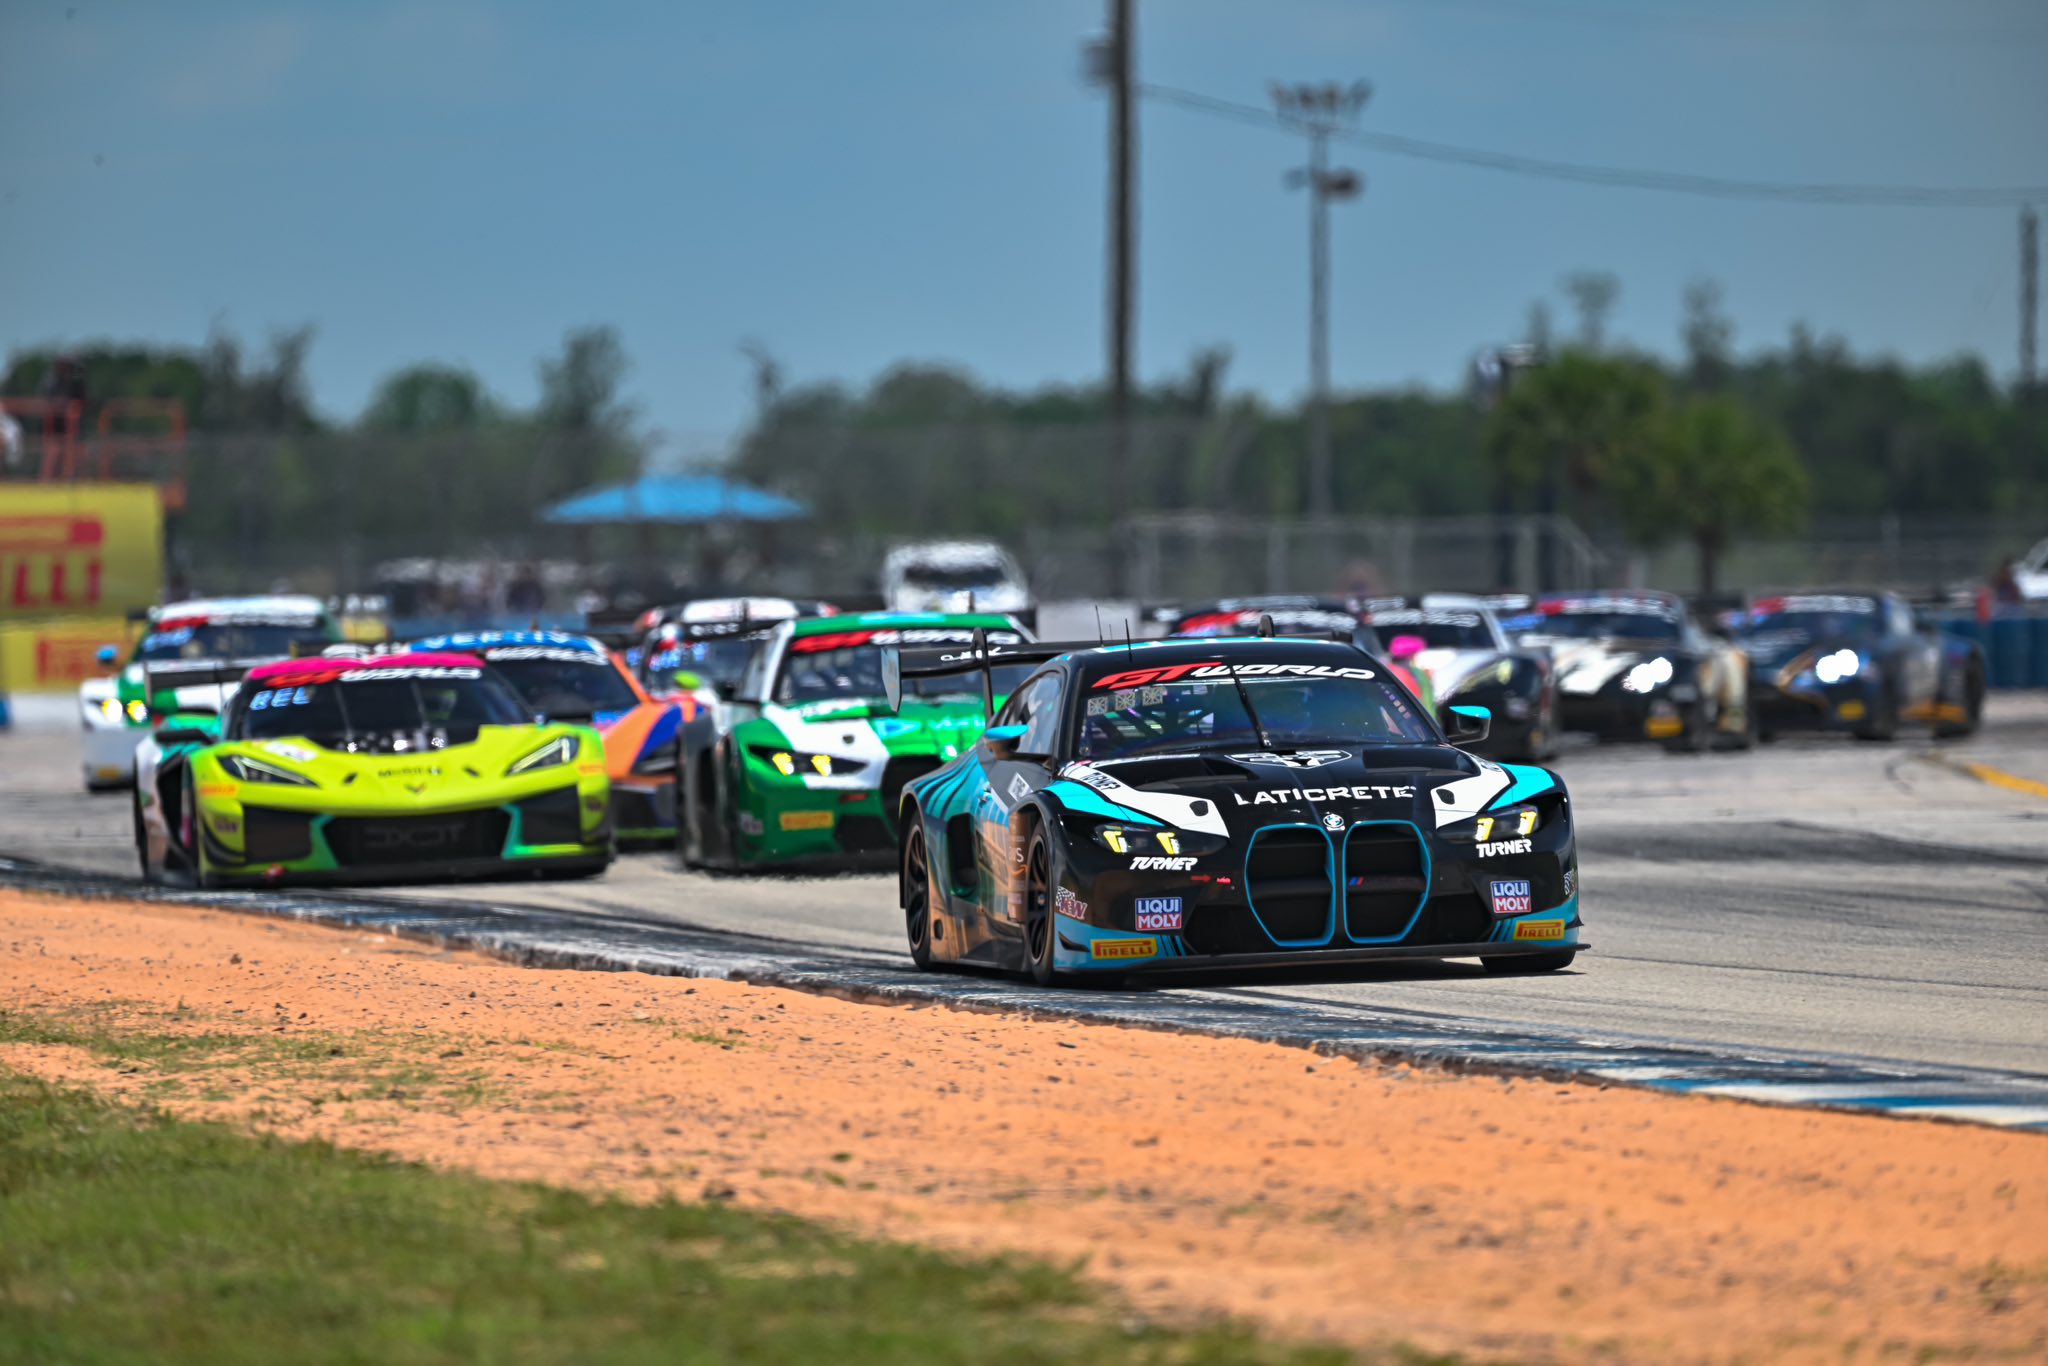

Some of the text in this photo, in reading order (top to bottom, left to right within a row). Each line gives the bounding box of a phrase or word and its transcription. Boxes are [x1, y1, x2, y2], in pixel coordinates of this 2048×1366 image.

[1234, 785, 1415, 806] LATICRETE
[1475, 839, 1533, 858] TURNER
[1129, 856, 1198, 871] TURNER
[1493, 882, 1528, 896] LIQUI
[1138, 900, 1180, 914] LIQUI
[1495, 897, 1530, 911] MOLY
[1138, 915, 1180, 929] MOLY
[1516, 922, 1562, 938] PIRELLI
[1095, 940, 1153, 957] PIRELLI
